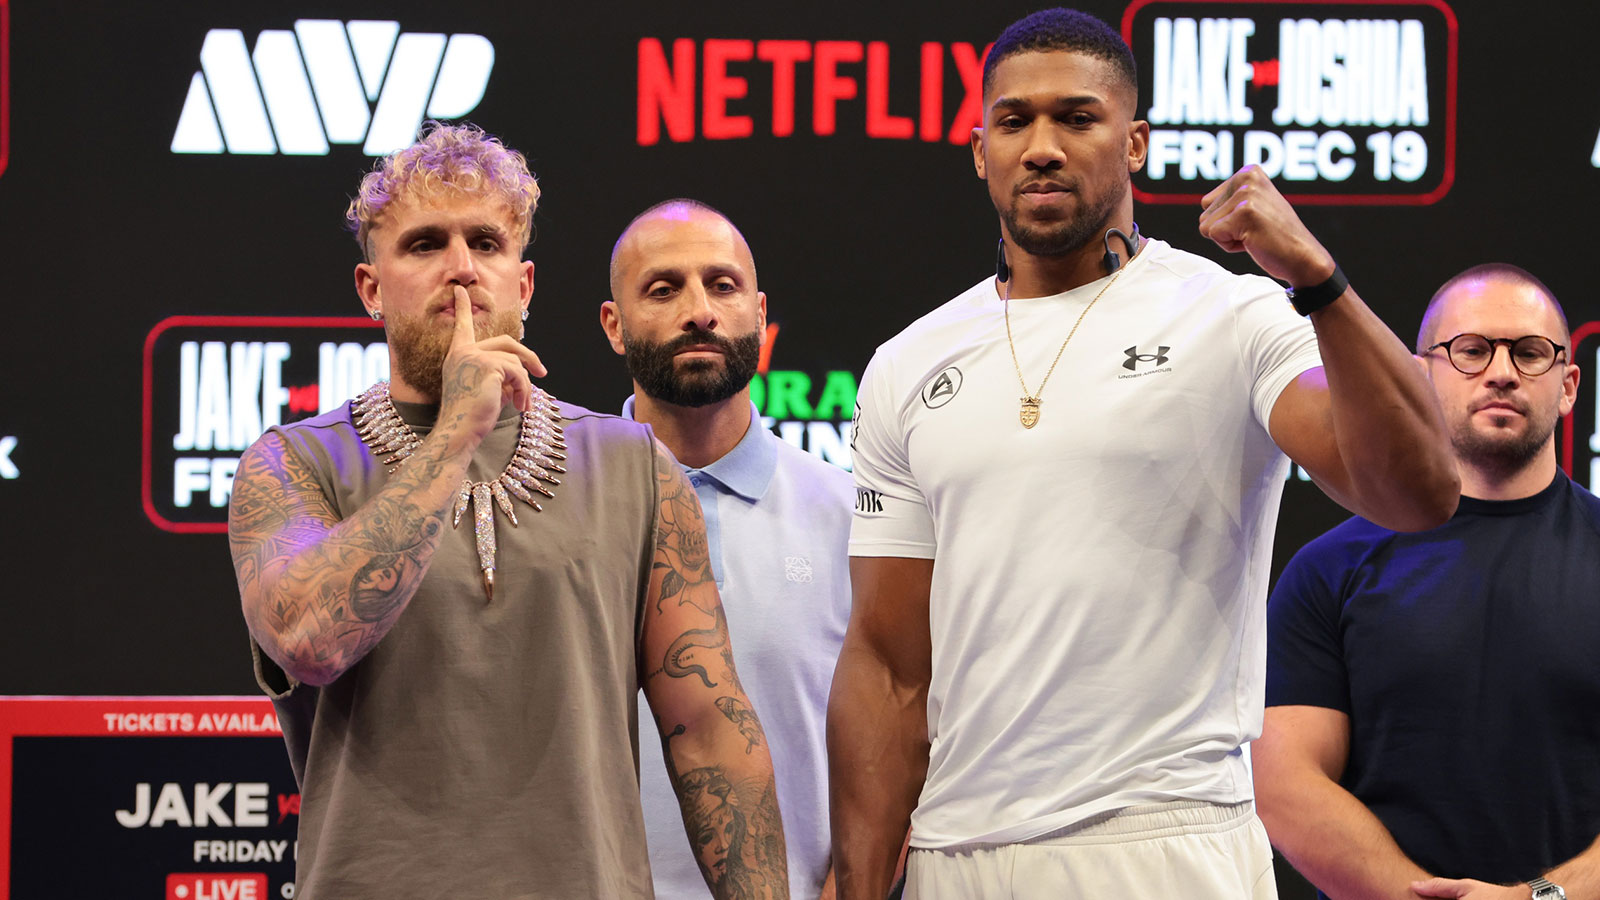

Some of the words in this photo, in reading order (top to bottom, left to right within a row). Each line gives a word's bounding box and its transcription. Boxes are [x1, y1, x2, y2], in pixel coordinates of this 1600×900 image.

[170, 19, 496, 156] MVP
[636, 37, 995, 146] NETFLIX
[1147, 17, 1255, 125] JAKE
[1272, 18, 1429, 127] JOSHUA
[1147, 129, 1234, 180] FRI
[1243, 129, 1356, 182] DEC
[1366, 130, 1428, 183] 19
[173, 341, 291, 451] JAKE
[1143, 367, 1172, 376] ARMOUR
[103, 713, 195, 732] TICKETS
[115, 782, 270, 828] JAKE
[193, 840, 288, 863] FRIDAY
[194, 879, 258, 900] LIVE
